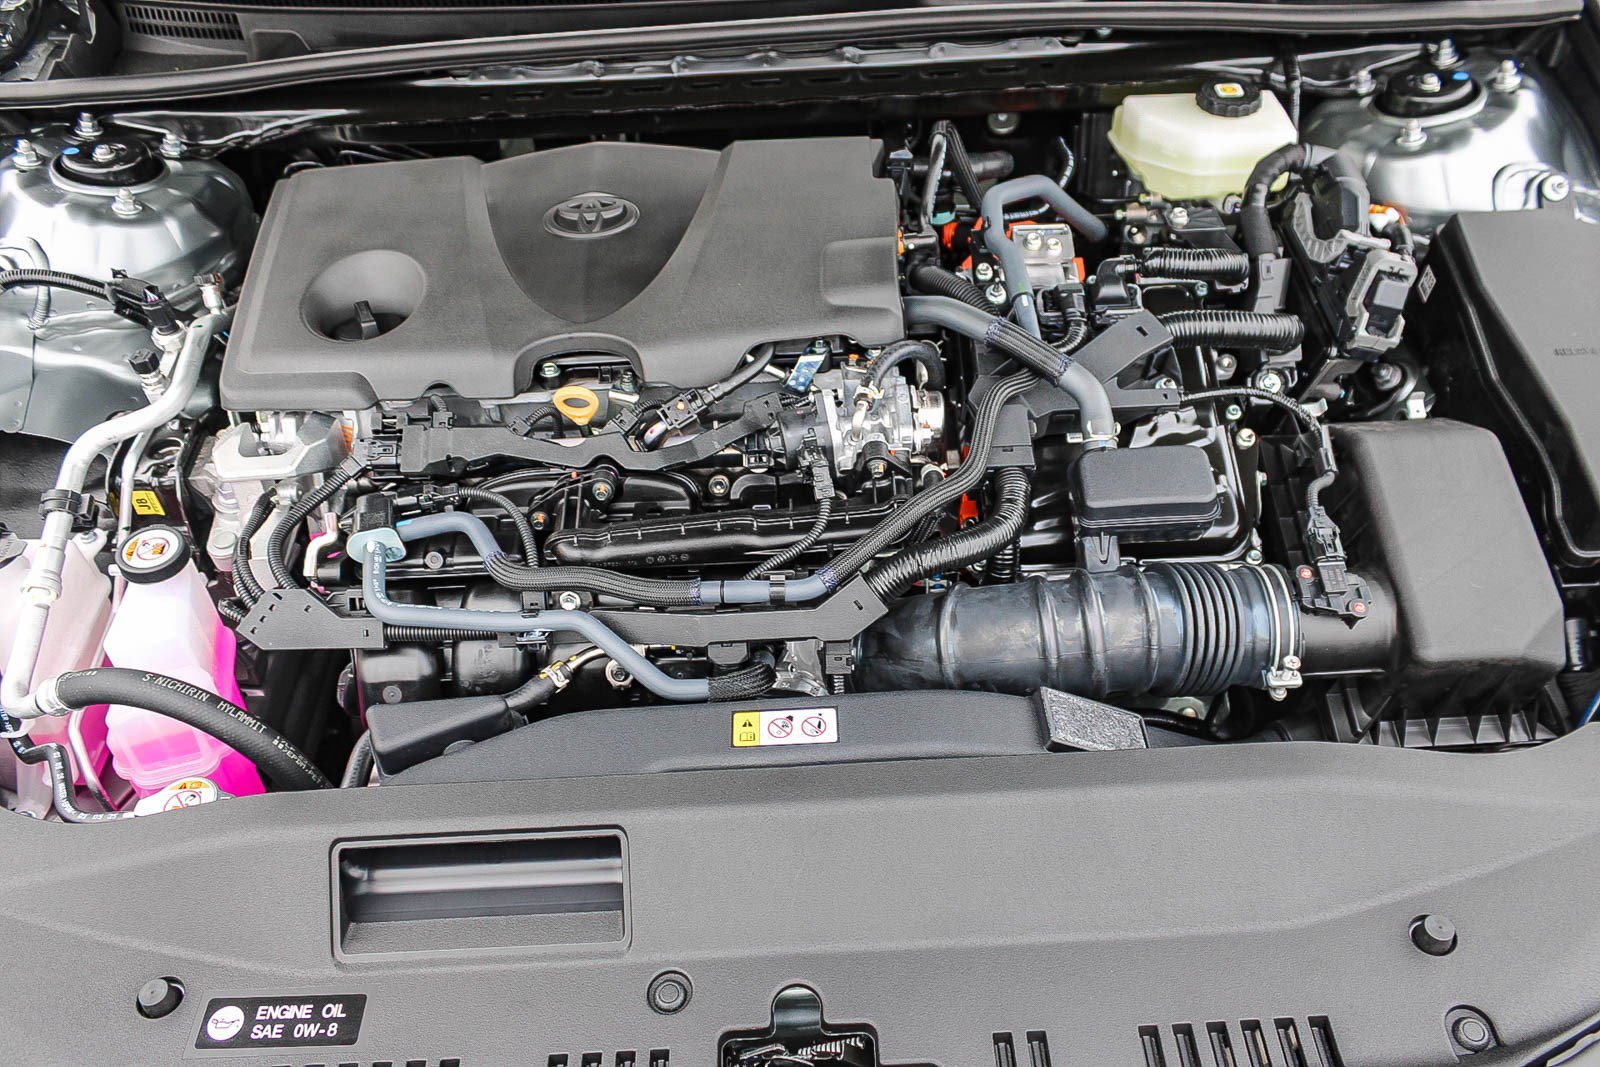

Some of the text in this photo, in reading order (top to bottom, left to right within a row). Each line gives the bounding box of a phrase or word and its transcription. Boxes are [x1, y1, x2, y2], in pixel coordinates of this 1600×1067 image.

[216, 700, 268, 734] HYLAMMIT
[255, 1003, 347, 1020] ENGINE OIL
[250, 1022, 338, 1039] SAE 0W-8
